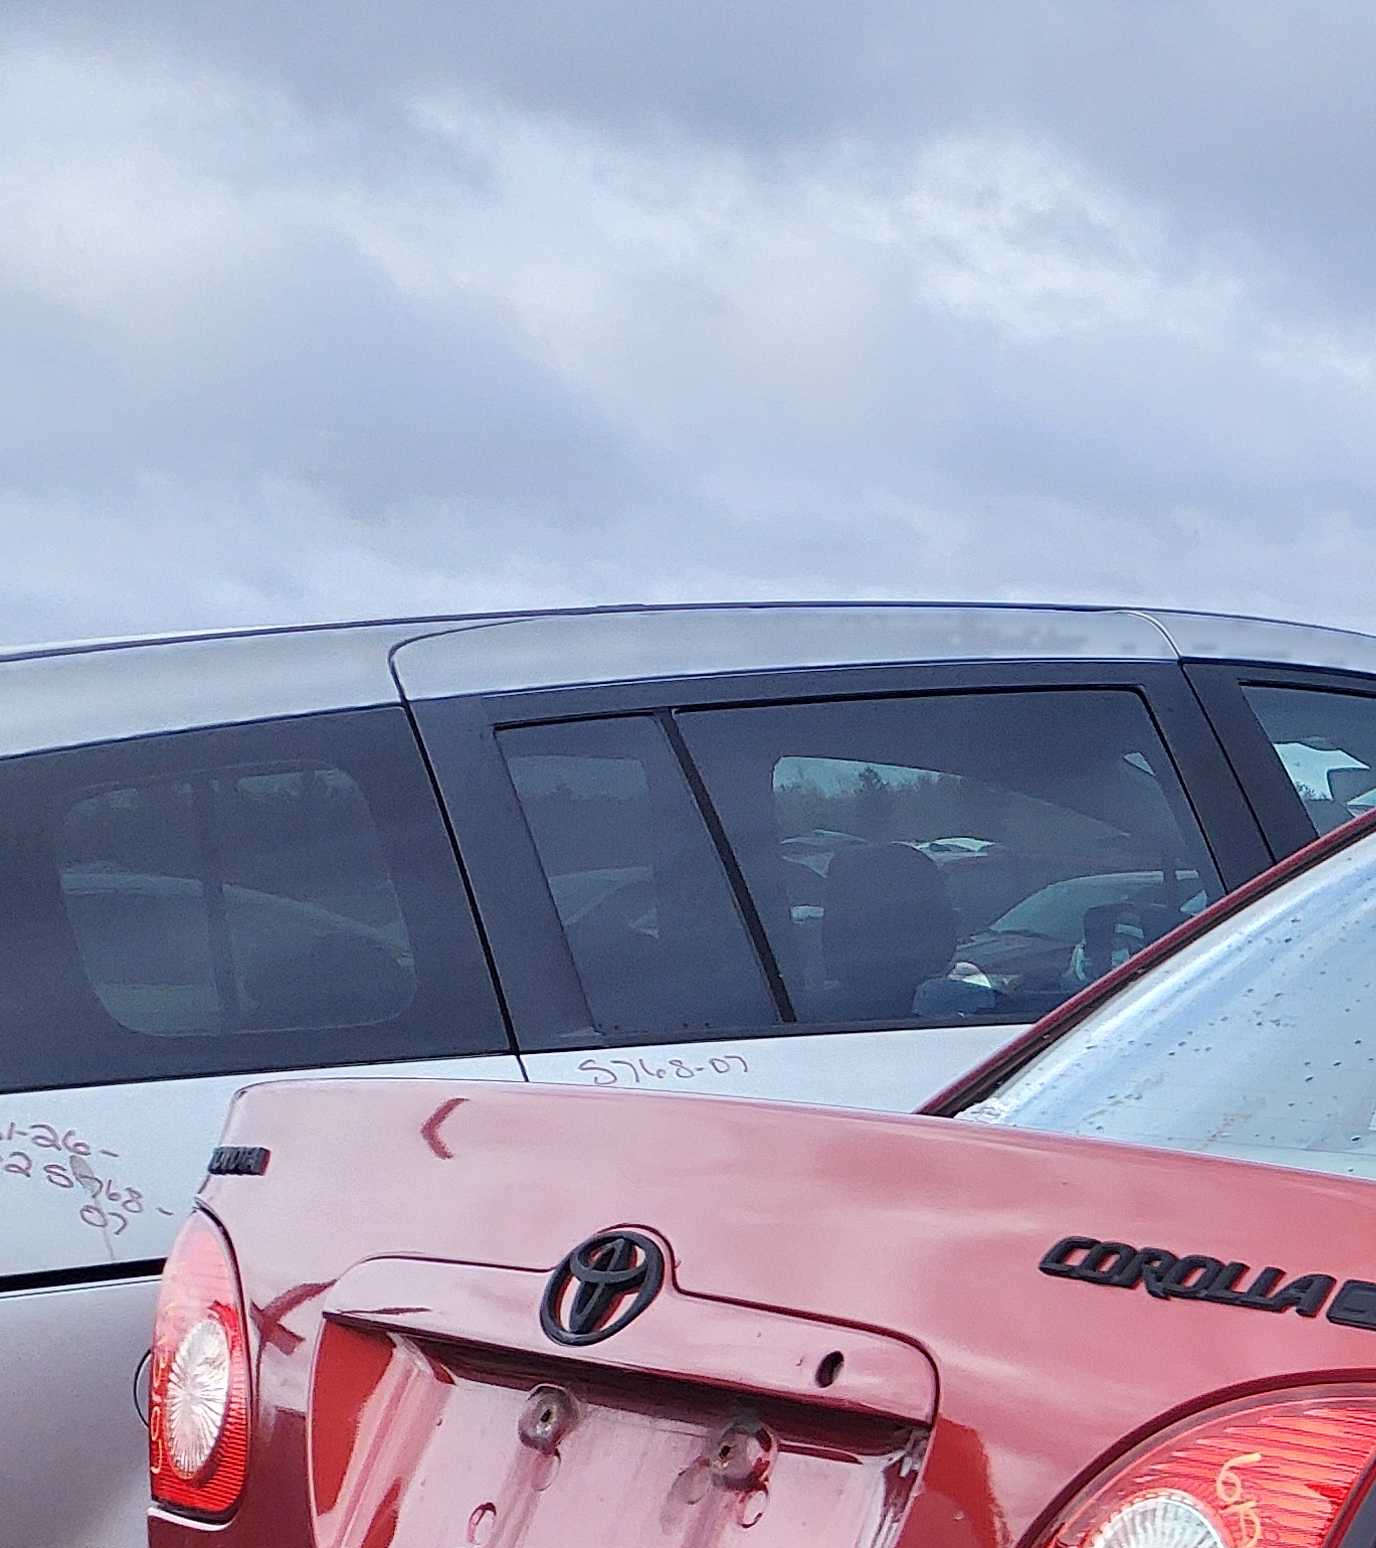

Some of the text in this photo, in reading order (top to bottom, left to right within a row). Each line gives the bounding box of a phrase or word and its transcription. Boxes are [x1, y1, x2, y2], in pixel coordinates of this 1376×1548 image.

[0, 1121, 120, 1157] 1-26-
[0, 1151, 32, 1178] 2
[80, 1204, 128, 1236] 07
[1038, 1236, 1338, 1318] COROLLA
